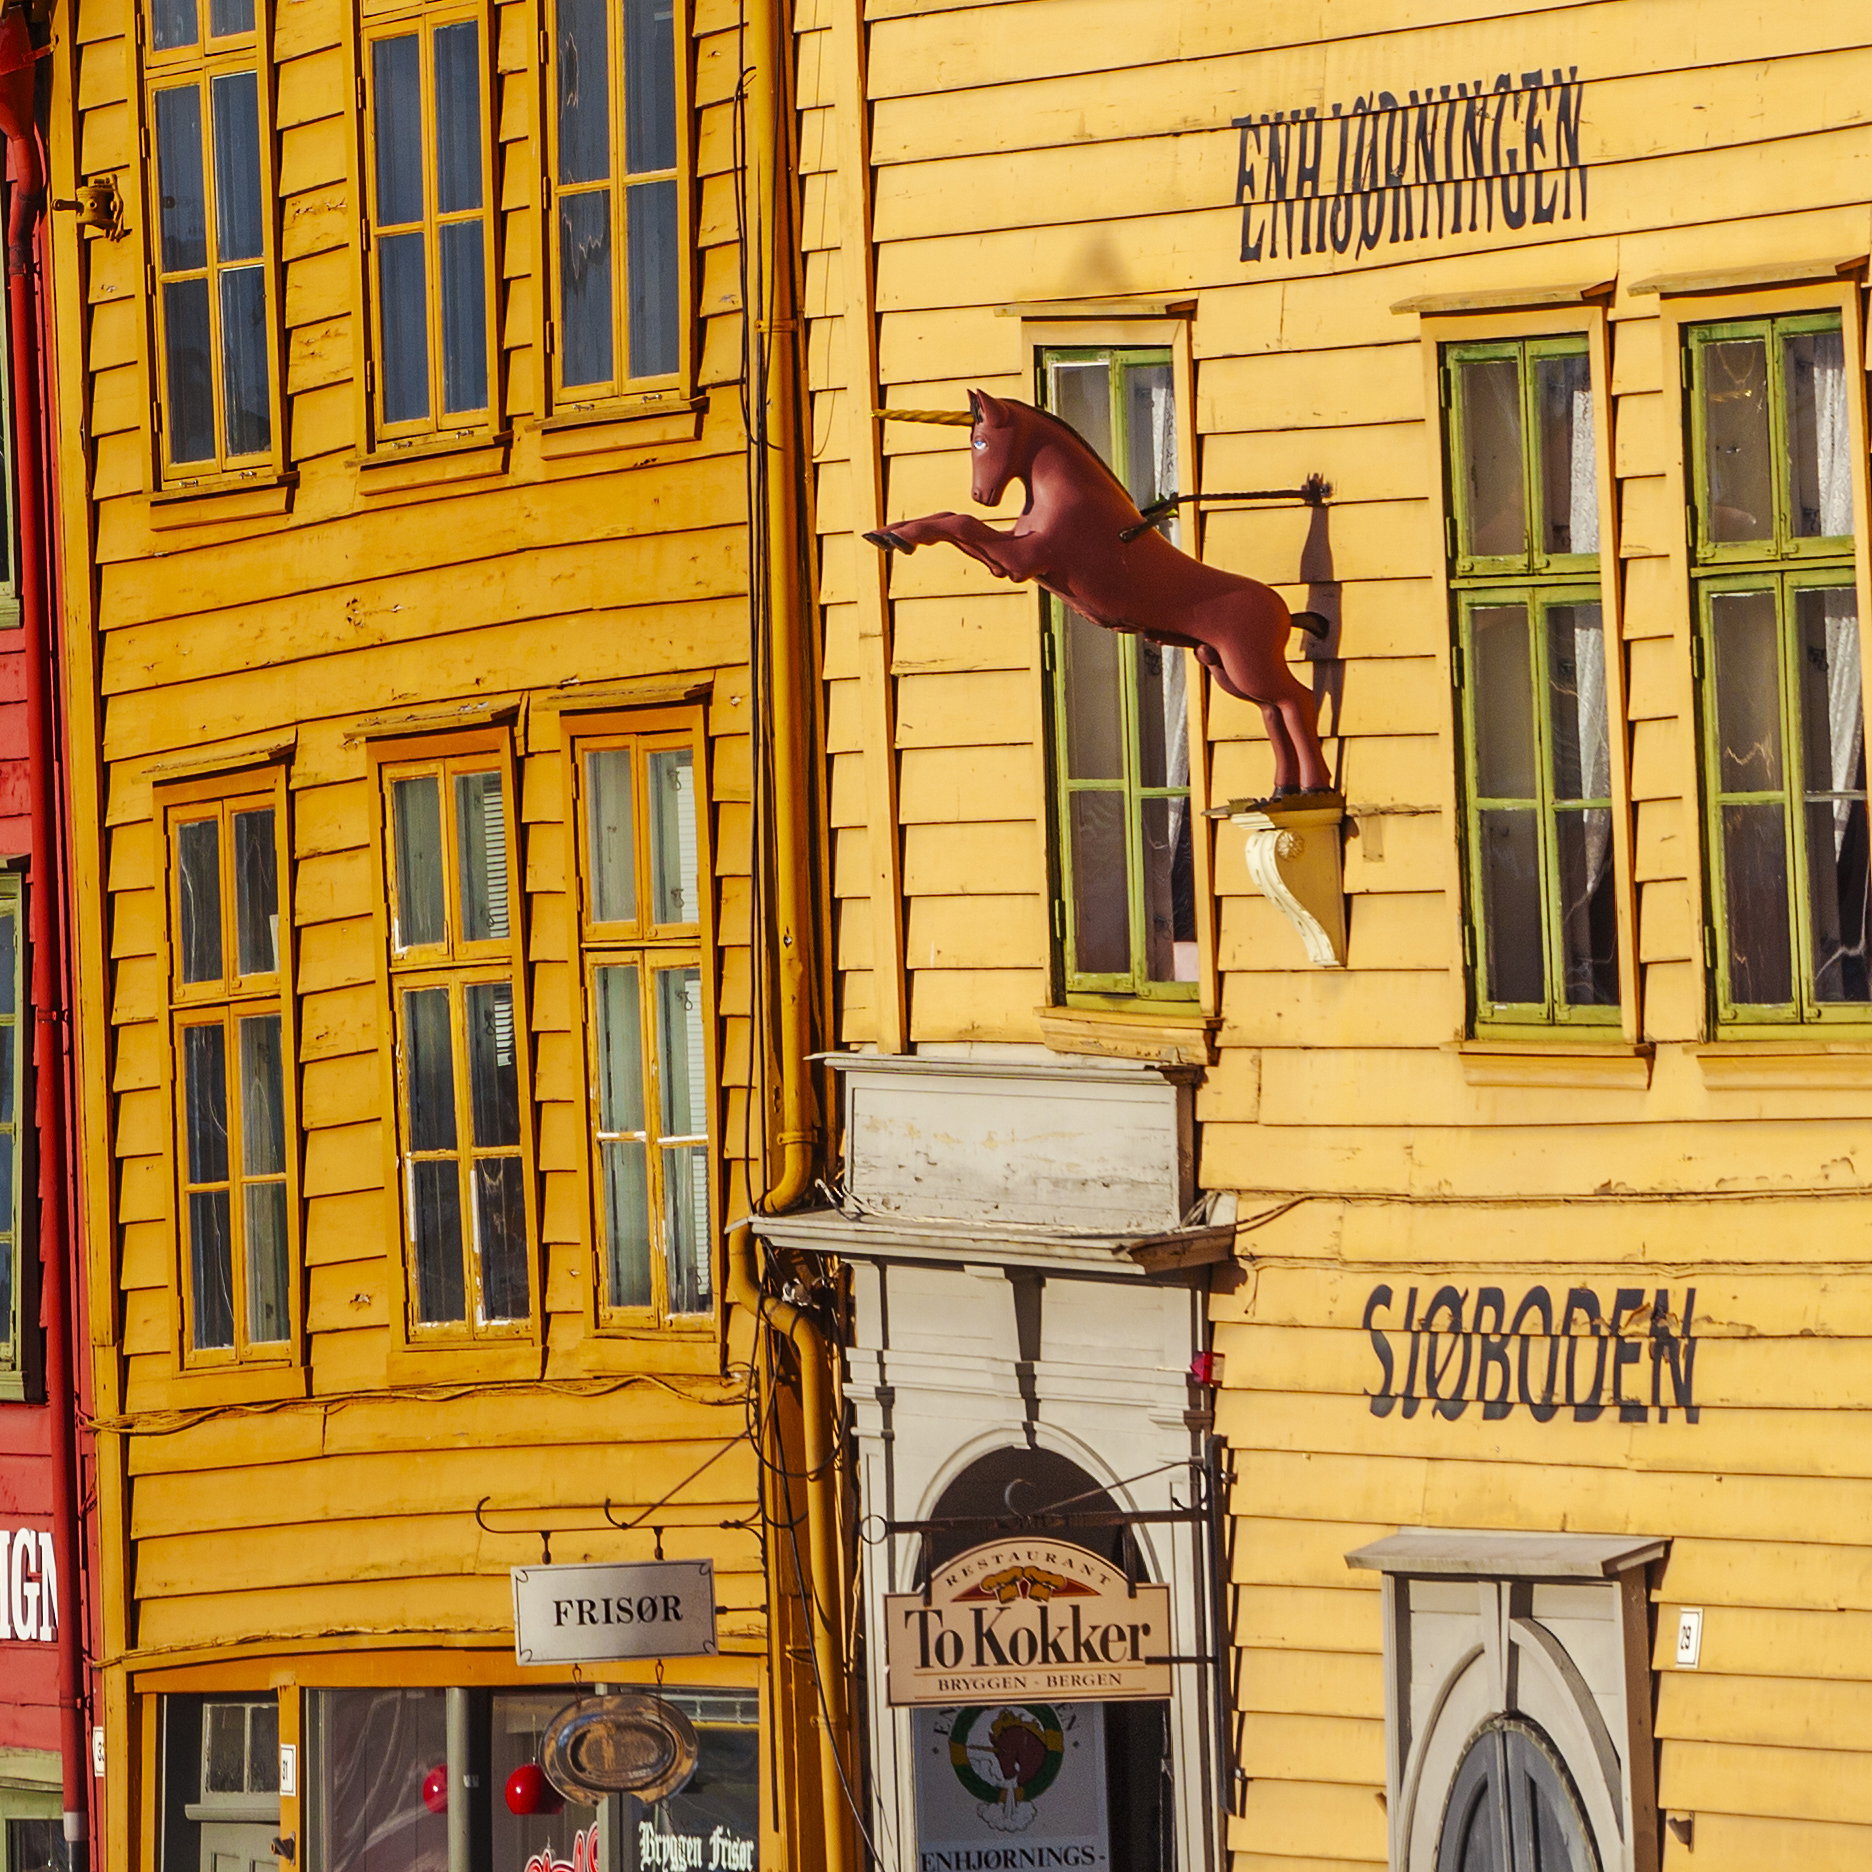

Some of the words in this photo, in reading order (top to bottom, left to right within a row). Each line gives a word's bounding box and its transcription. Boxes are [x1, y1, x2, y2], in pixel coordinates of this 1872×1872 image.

[1232, 65, 1588, 262] ENHJØRNINGEN
[1362, 1283, 1701, 1425] SJØBODEN
[945, 1549, 1112, 1588] RESTAURANT
[553, 1594, 684, 1627] FRISØR
[904, 1609, 964, 1669] To
[969, 1603, 1151, 1668] Kokker
[937, 1677, 1027, 1692] BRYGGEN
[1046, 1672, 1124, 1687] BERGEN
[639, 1821, 703, 1872] Bryggen
